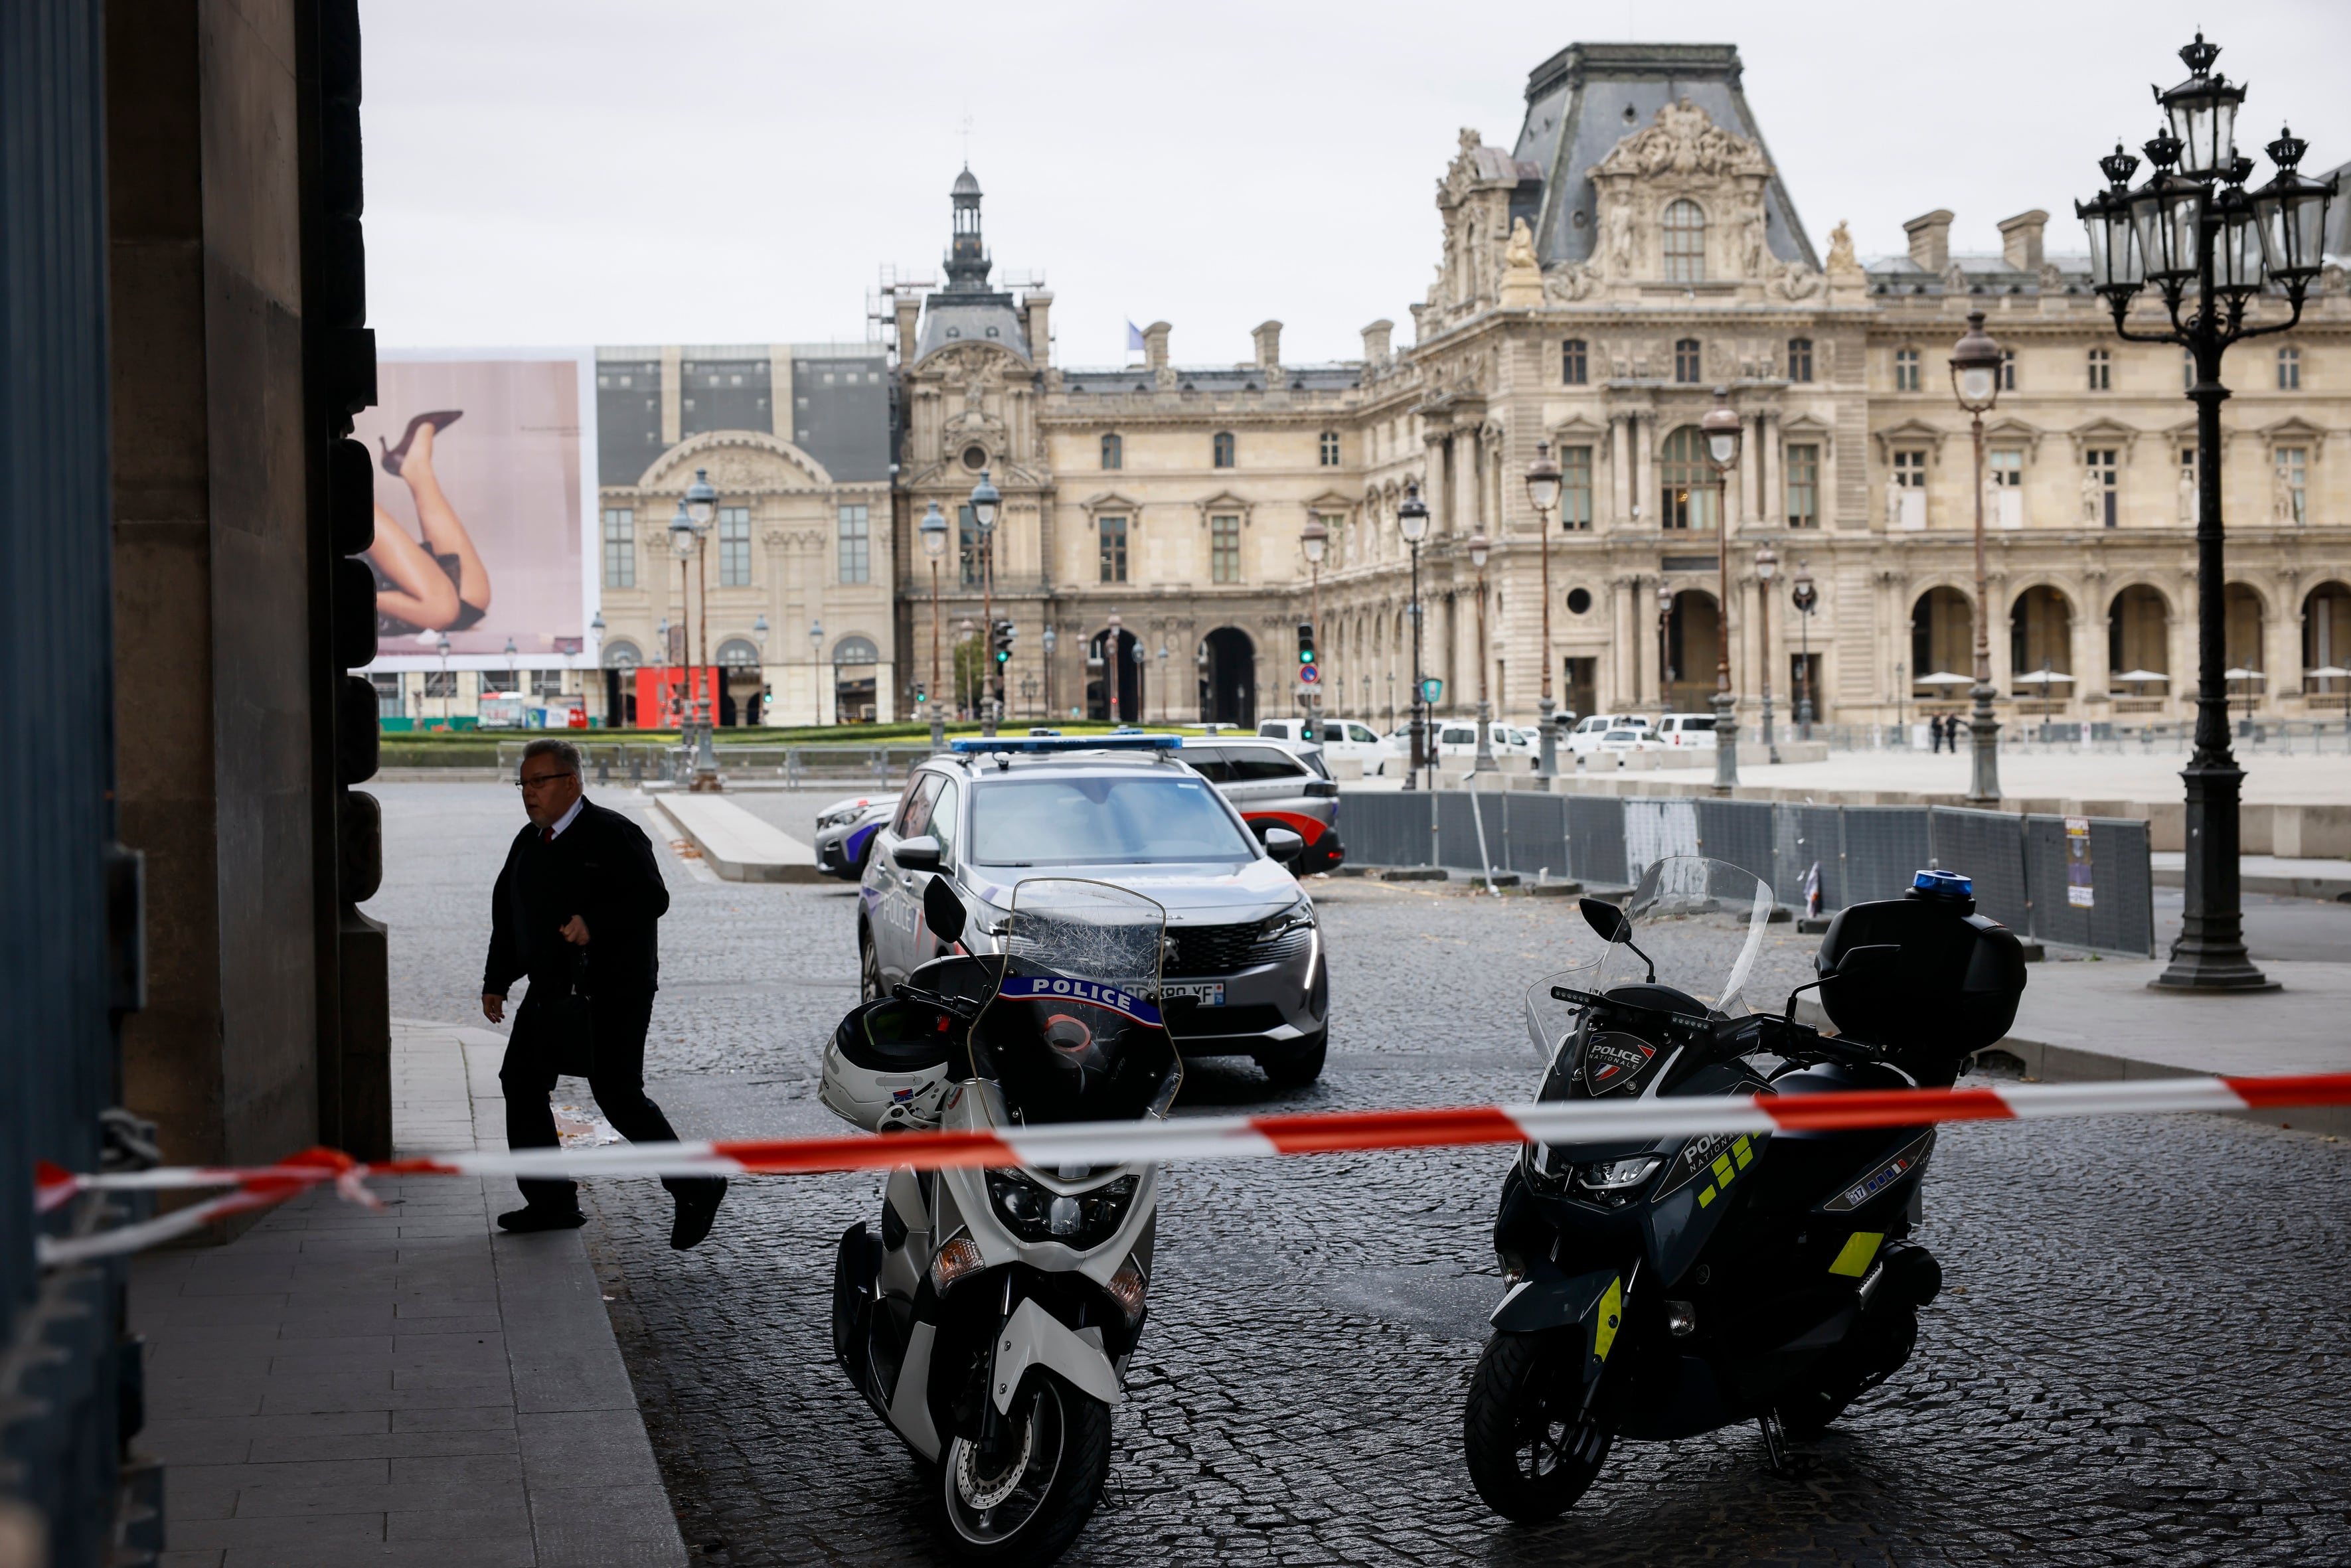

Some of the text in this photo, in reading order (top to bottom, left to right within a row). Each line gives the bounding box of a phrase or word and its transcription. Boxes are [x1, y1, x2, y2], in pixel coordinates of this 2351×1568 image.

[884, 894, 912, 933] POLICE
[1032, 979, 1131, 1010] POLICE
[1588, 1054, 1638, 1069] NATIONALE
[1591, 1045, 1642, 1063] POLICE
[1854, 1187, 1864, 1198] 17
